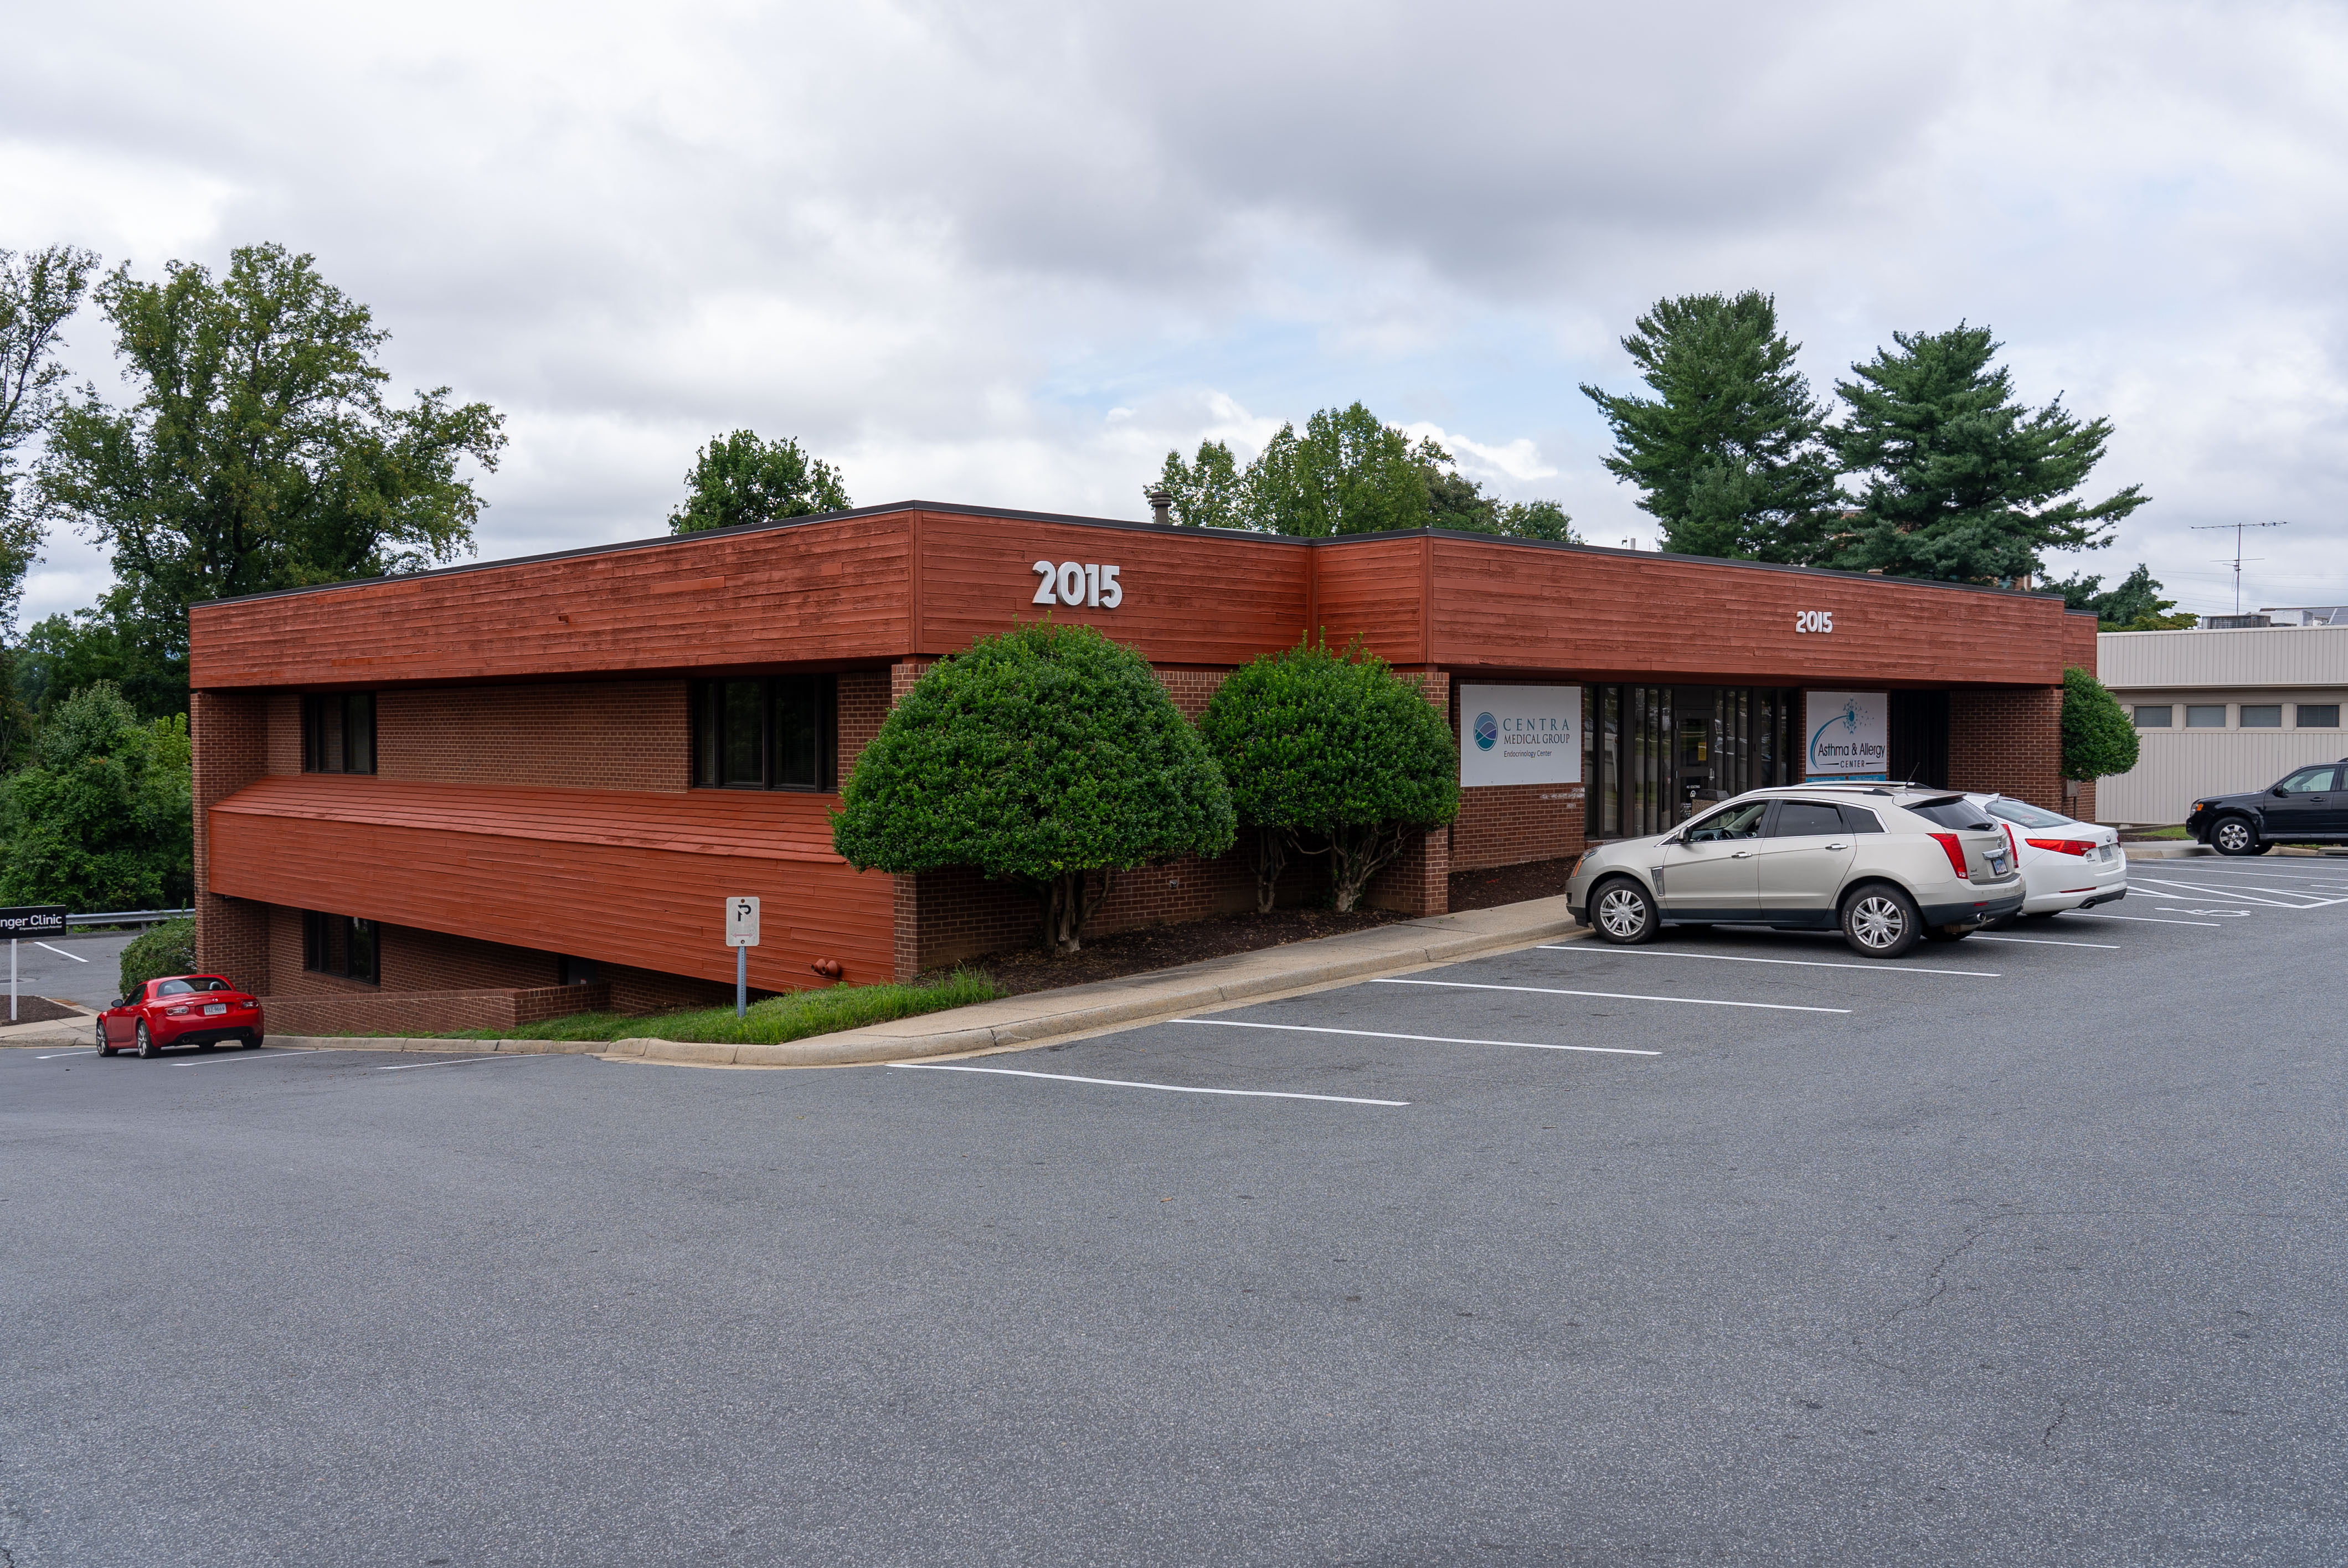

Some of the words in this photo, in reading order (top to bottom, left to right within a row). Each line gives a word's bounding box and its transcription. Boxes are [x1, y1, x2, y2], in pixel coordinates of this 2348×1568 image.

[1032, 560, 1122, 608] 2015
[1795, 611, 1833, 633] 2015
[1503, 718, 1570, 731] CENTRA
[1504, 734, 1541, 745] MEDICAL
[1542, 734, 1570, 744] GROUP
[1503, 750, 1536, 759] Endocrinology
[1818, 743, 1849, 756] Asthma
[1851, 742, 1857, 756] &
[1860, 742, 1886, 759] Allergy
[1840, 760, 1865, 768] CENTER
[737, 905, 751, 922] P
[0, 917, 28, 929] nger
[30, 914, 62, 925] Clinic
